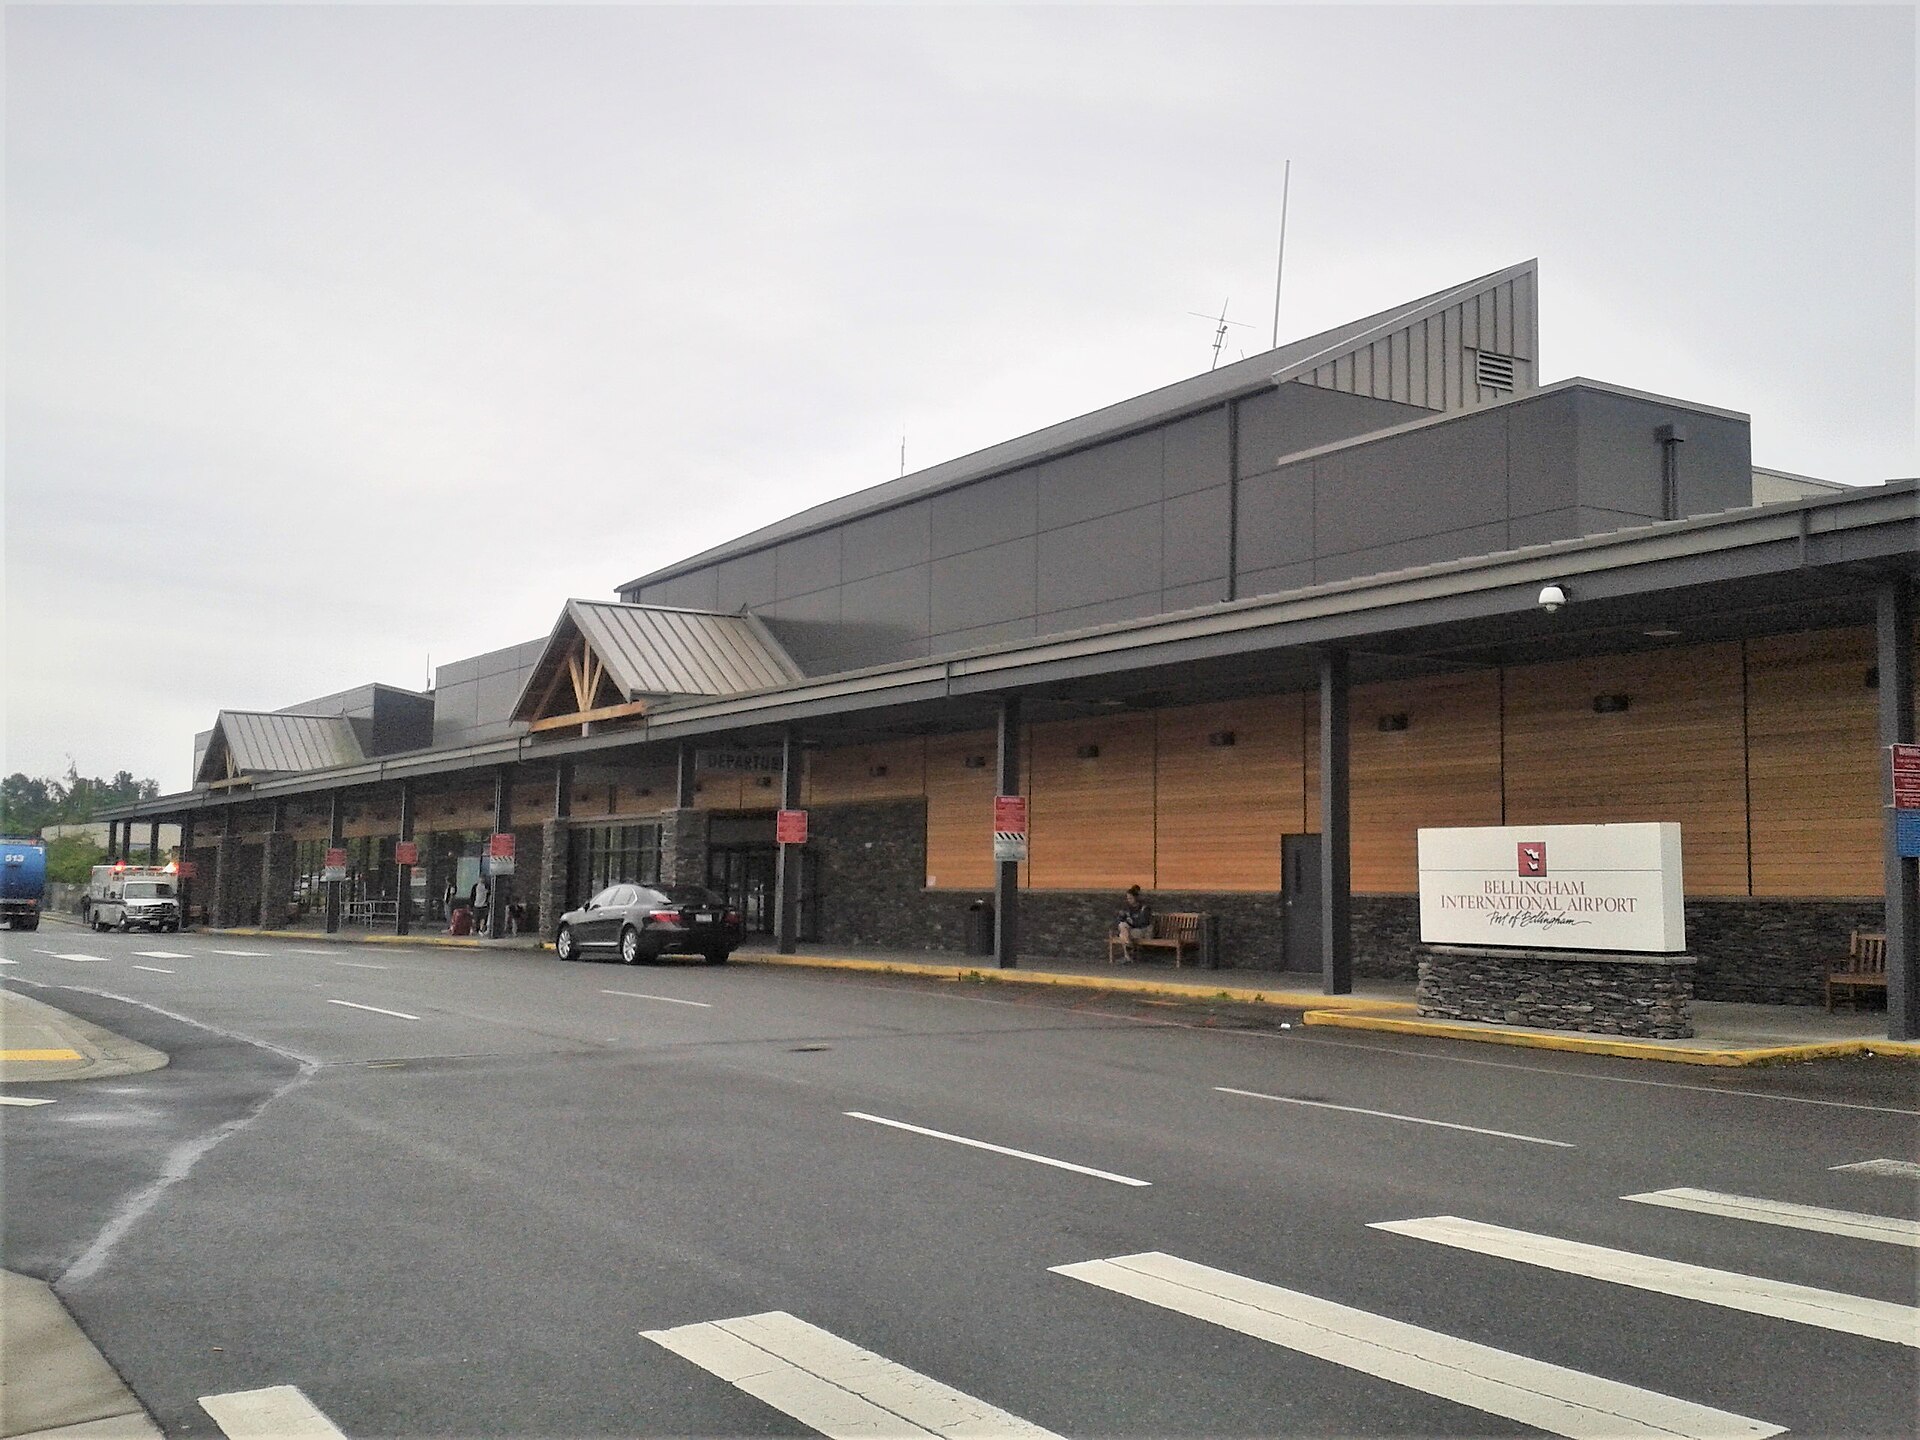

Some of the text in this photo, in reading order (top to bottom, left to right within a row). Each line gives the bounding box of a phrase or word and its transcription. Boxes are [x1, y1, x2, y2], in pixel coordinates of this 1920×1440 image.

[708, 753, 784, 771] DEPARTUR
[1484, 880, 1585, 895] BELLINGHAM
[1441, 895, 1637, 912] INTERNATIONAL AIRPORT
[1486, 910, 1592, 931] Port of Bellingham
